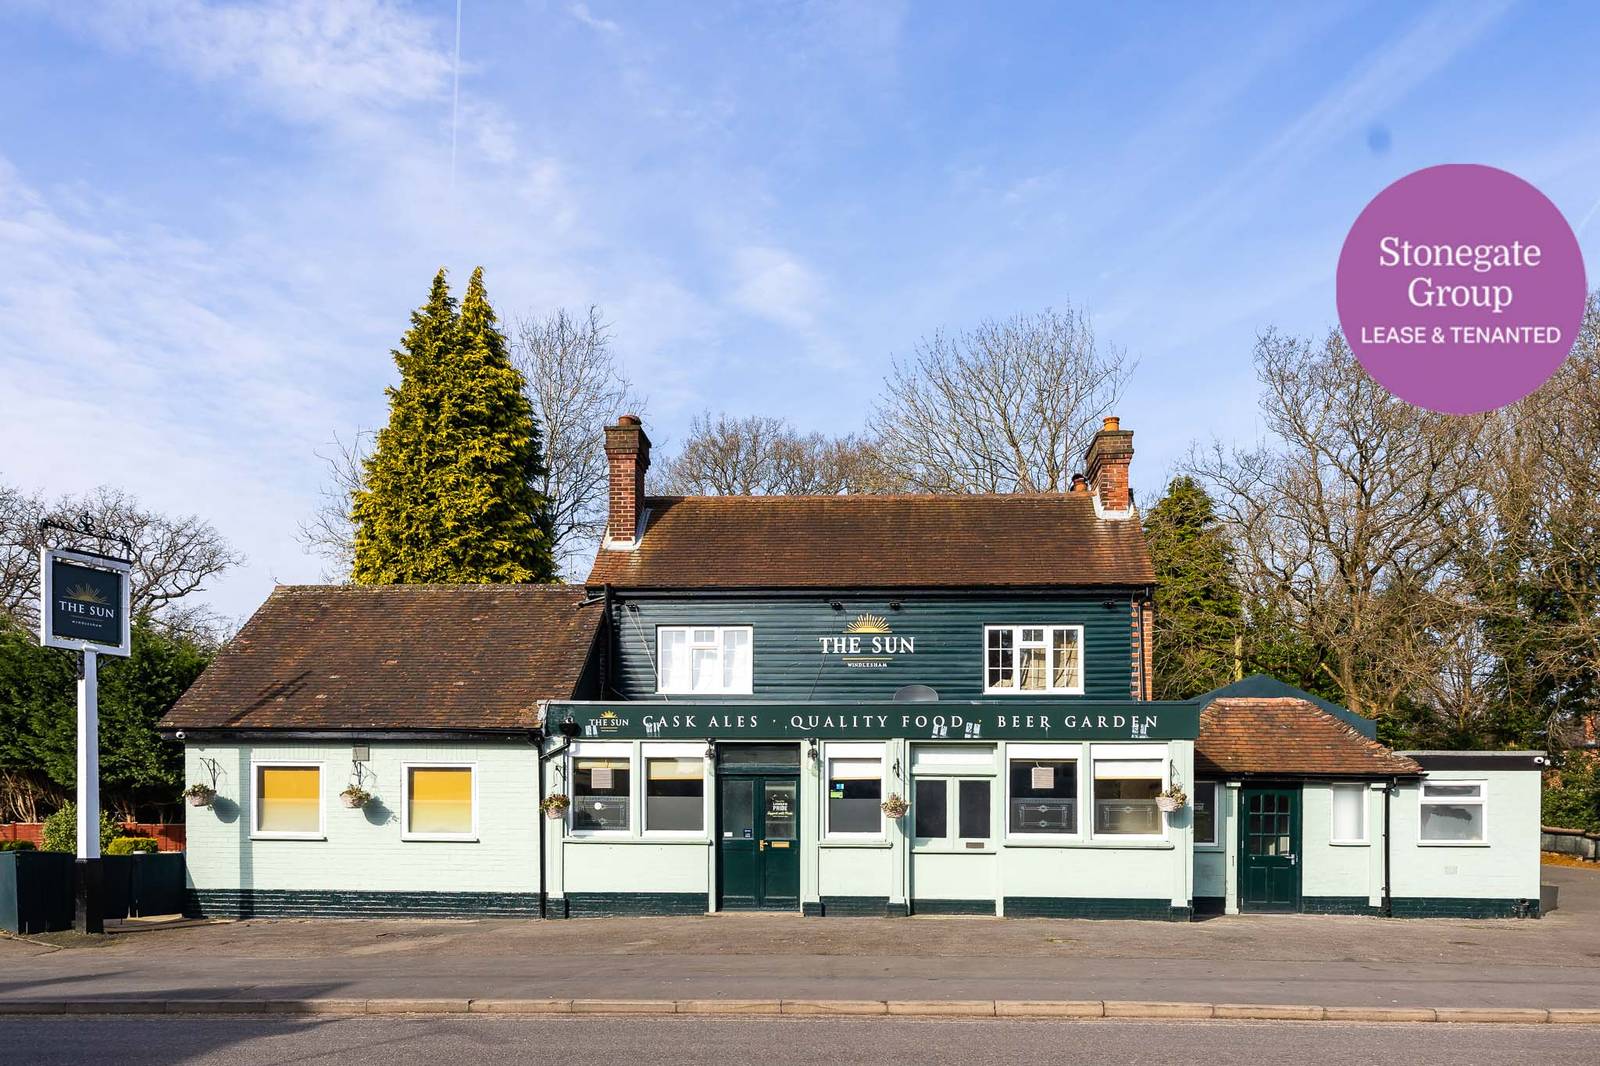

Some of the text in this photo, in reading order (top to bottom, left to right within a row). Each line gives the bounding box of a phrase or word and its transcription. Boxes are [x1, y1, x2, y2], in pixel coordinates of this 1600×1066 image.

[59, 600, 114, 619] THE SUN
[818, 636, 916, 654] THE SUN
[590, 719, 629, 727] THE SUN
[642, 715, 1159, 730] CASK ALES QUALITY FOOD BEER GARDEN
